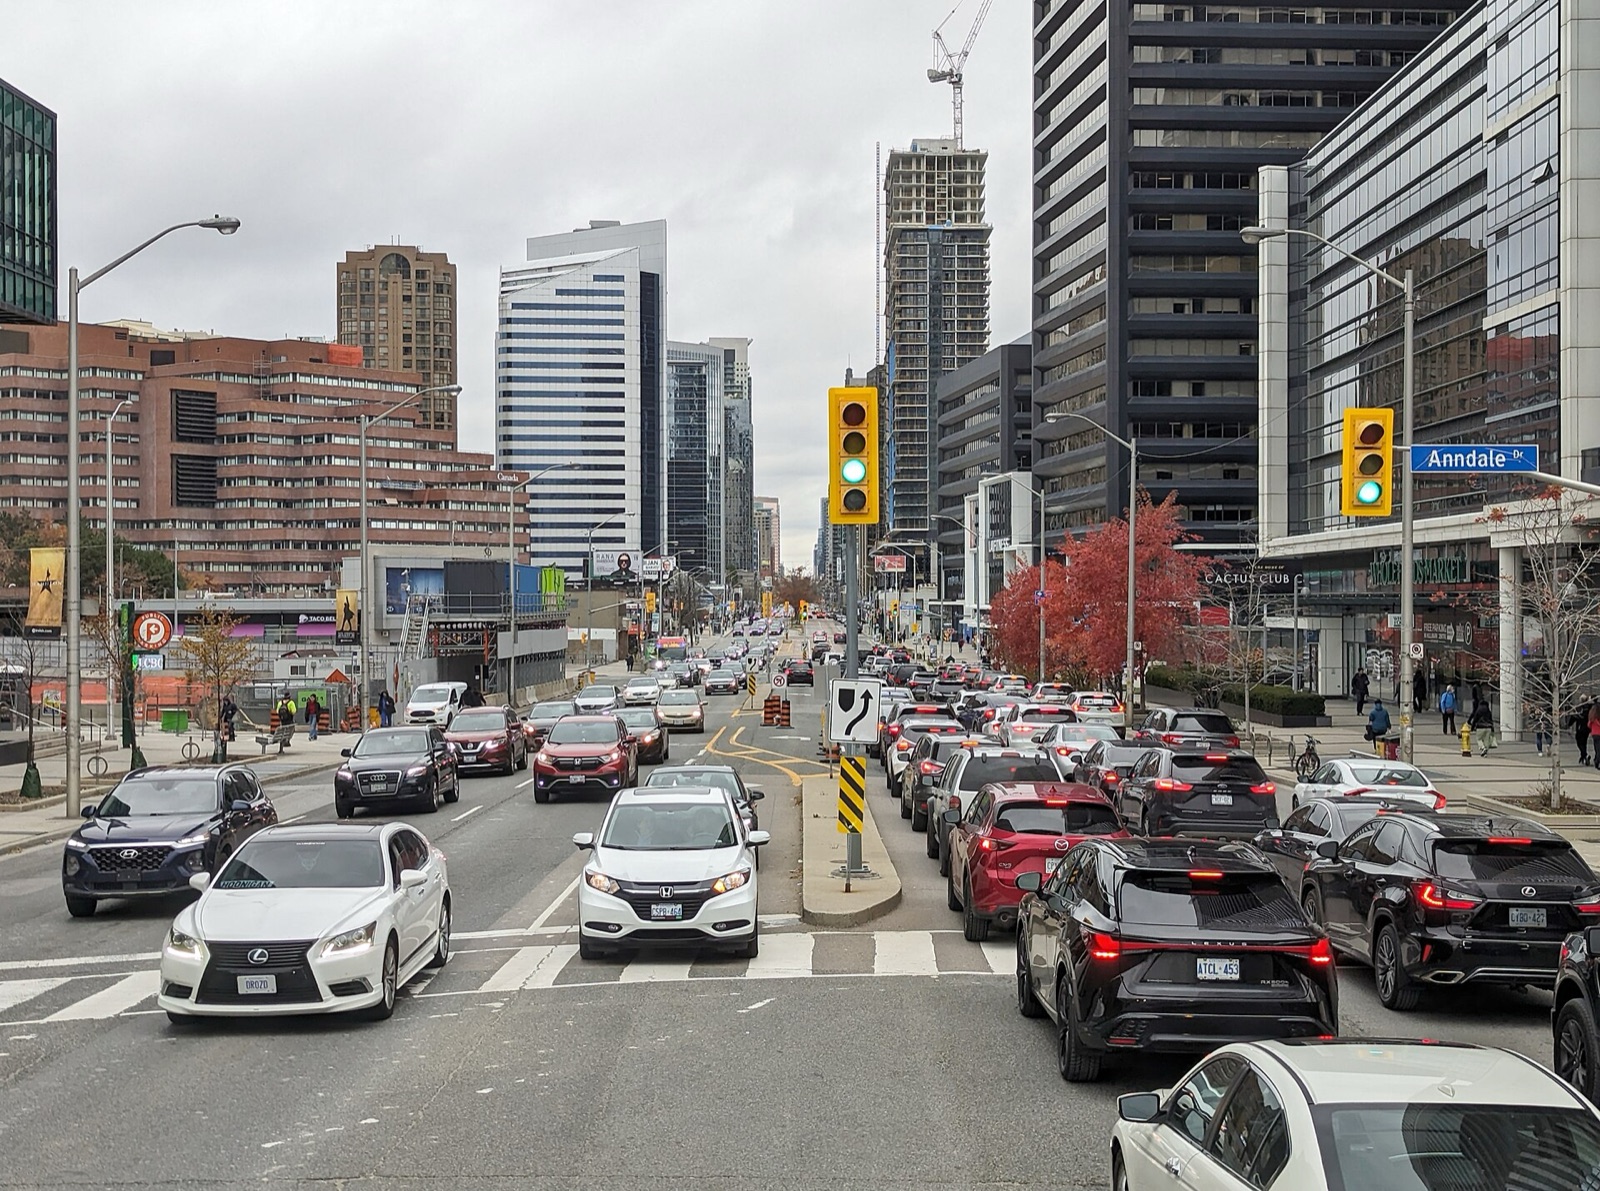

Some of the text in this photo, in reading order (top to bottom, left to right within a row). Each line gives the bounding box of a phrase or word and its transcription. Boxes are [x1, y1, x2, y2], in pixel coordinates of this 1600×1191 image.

[1427, 449, 1506, 468] Anndale
[497, 472, 519, 482] Canada
[1370, 561, 1397, 586] WHOLE
[1424, 555, 1462, 583] MARKET
[1205, 573, 1255, 584] CACTUS
[1260, 573, 1290, 584] CLUB
[141, 612, 165, 620] PUBLIC
[220, 880, 275, 888] HOONIGAN
[1198, 963, 1239, 975] ATCL 453
